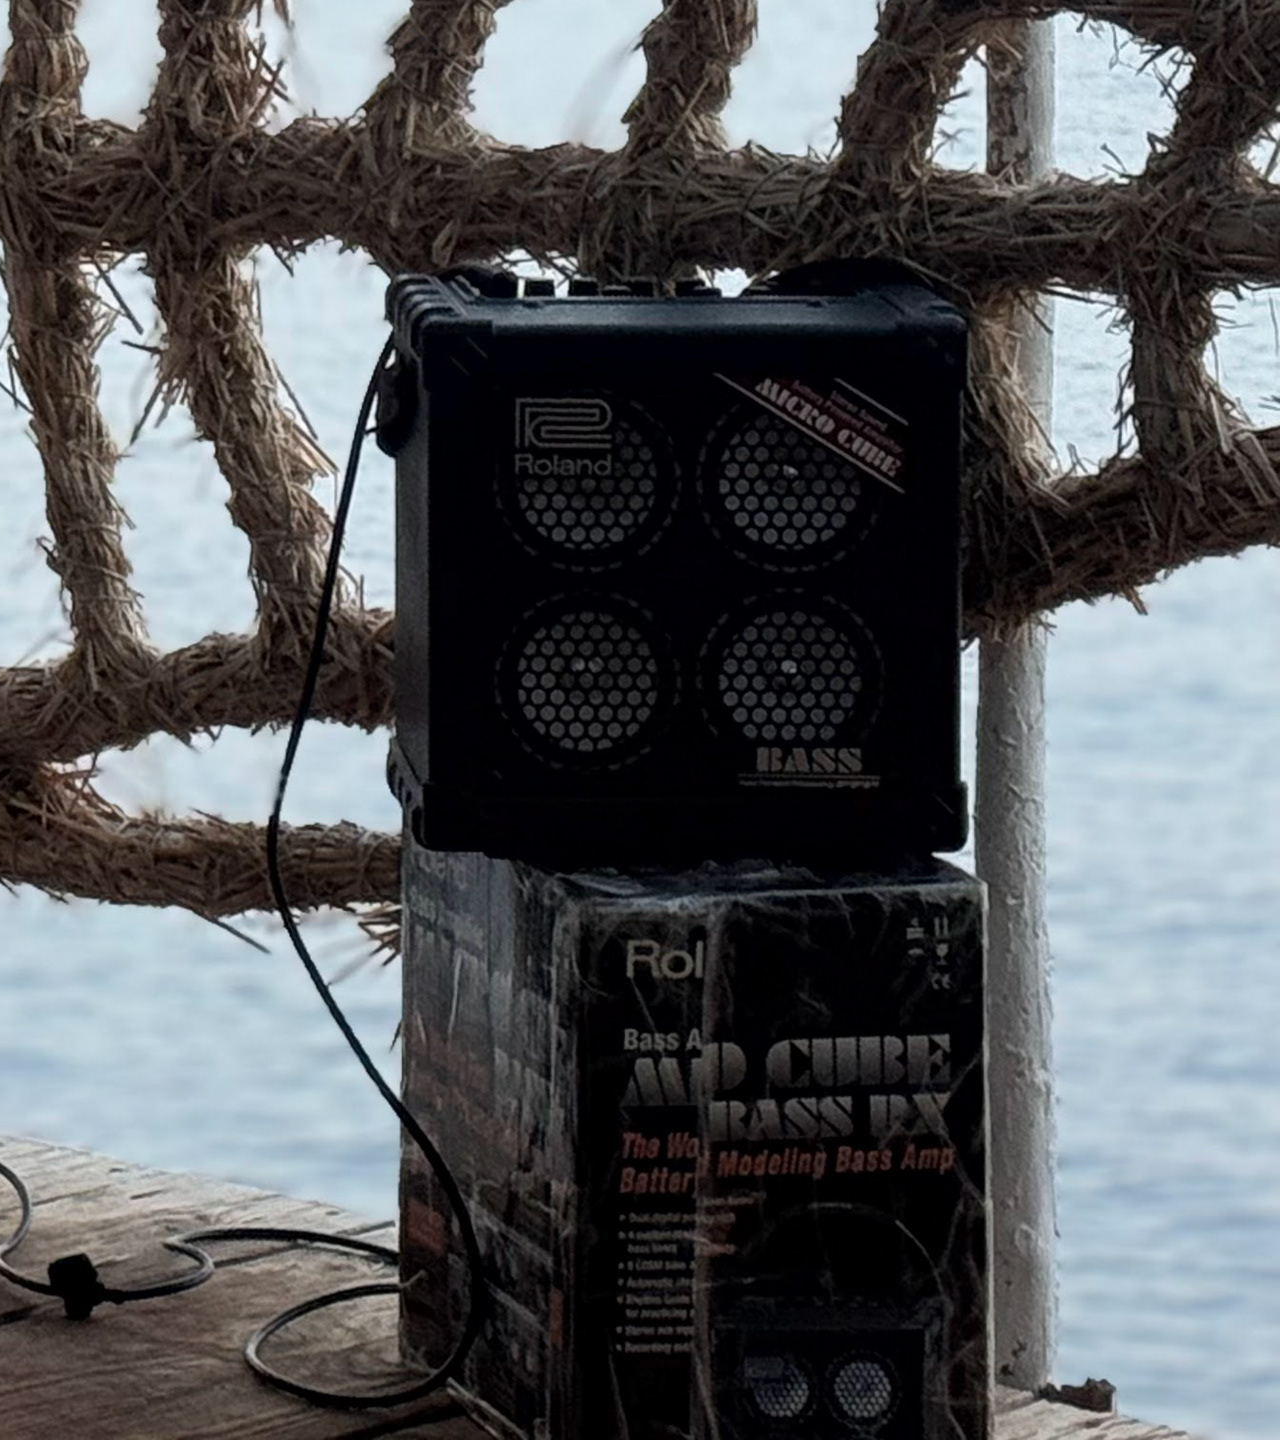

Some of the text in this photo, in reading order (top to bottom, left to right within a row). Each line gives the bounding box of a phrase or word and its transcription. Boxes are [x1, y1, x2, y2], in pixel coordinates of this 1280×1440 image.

[754, 377, 902, 478] MICRO CUBE
[514, 453, 612, 476] Roland
[756, 746, 863, 773] BASS
[623, 1028, 680, 1051] Bass
[765, 1033, 951, 1090] CUBE
[707, 1095, 854, 1142] BASS
[623, 1131, 661, 1160] The
[716, 1148, 827, 1180] Modeling
[835, 1146, 892, 1174] Bass
[900, 1143, 956, 1176] Amp
